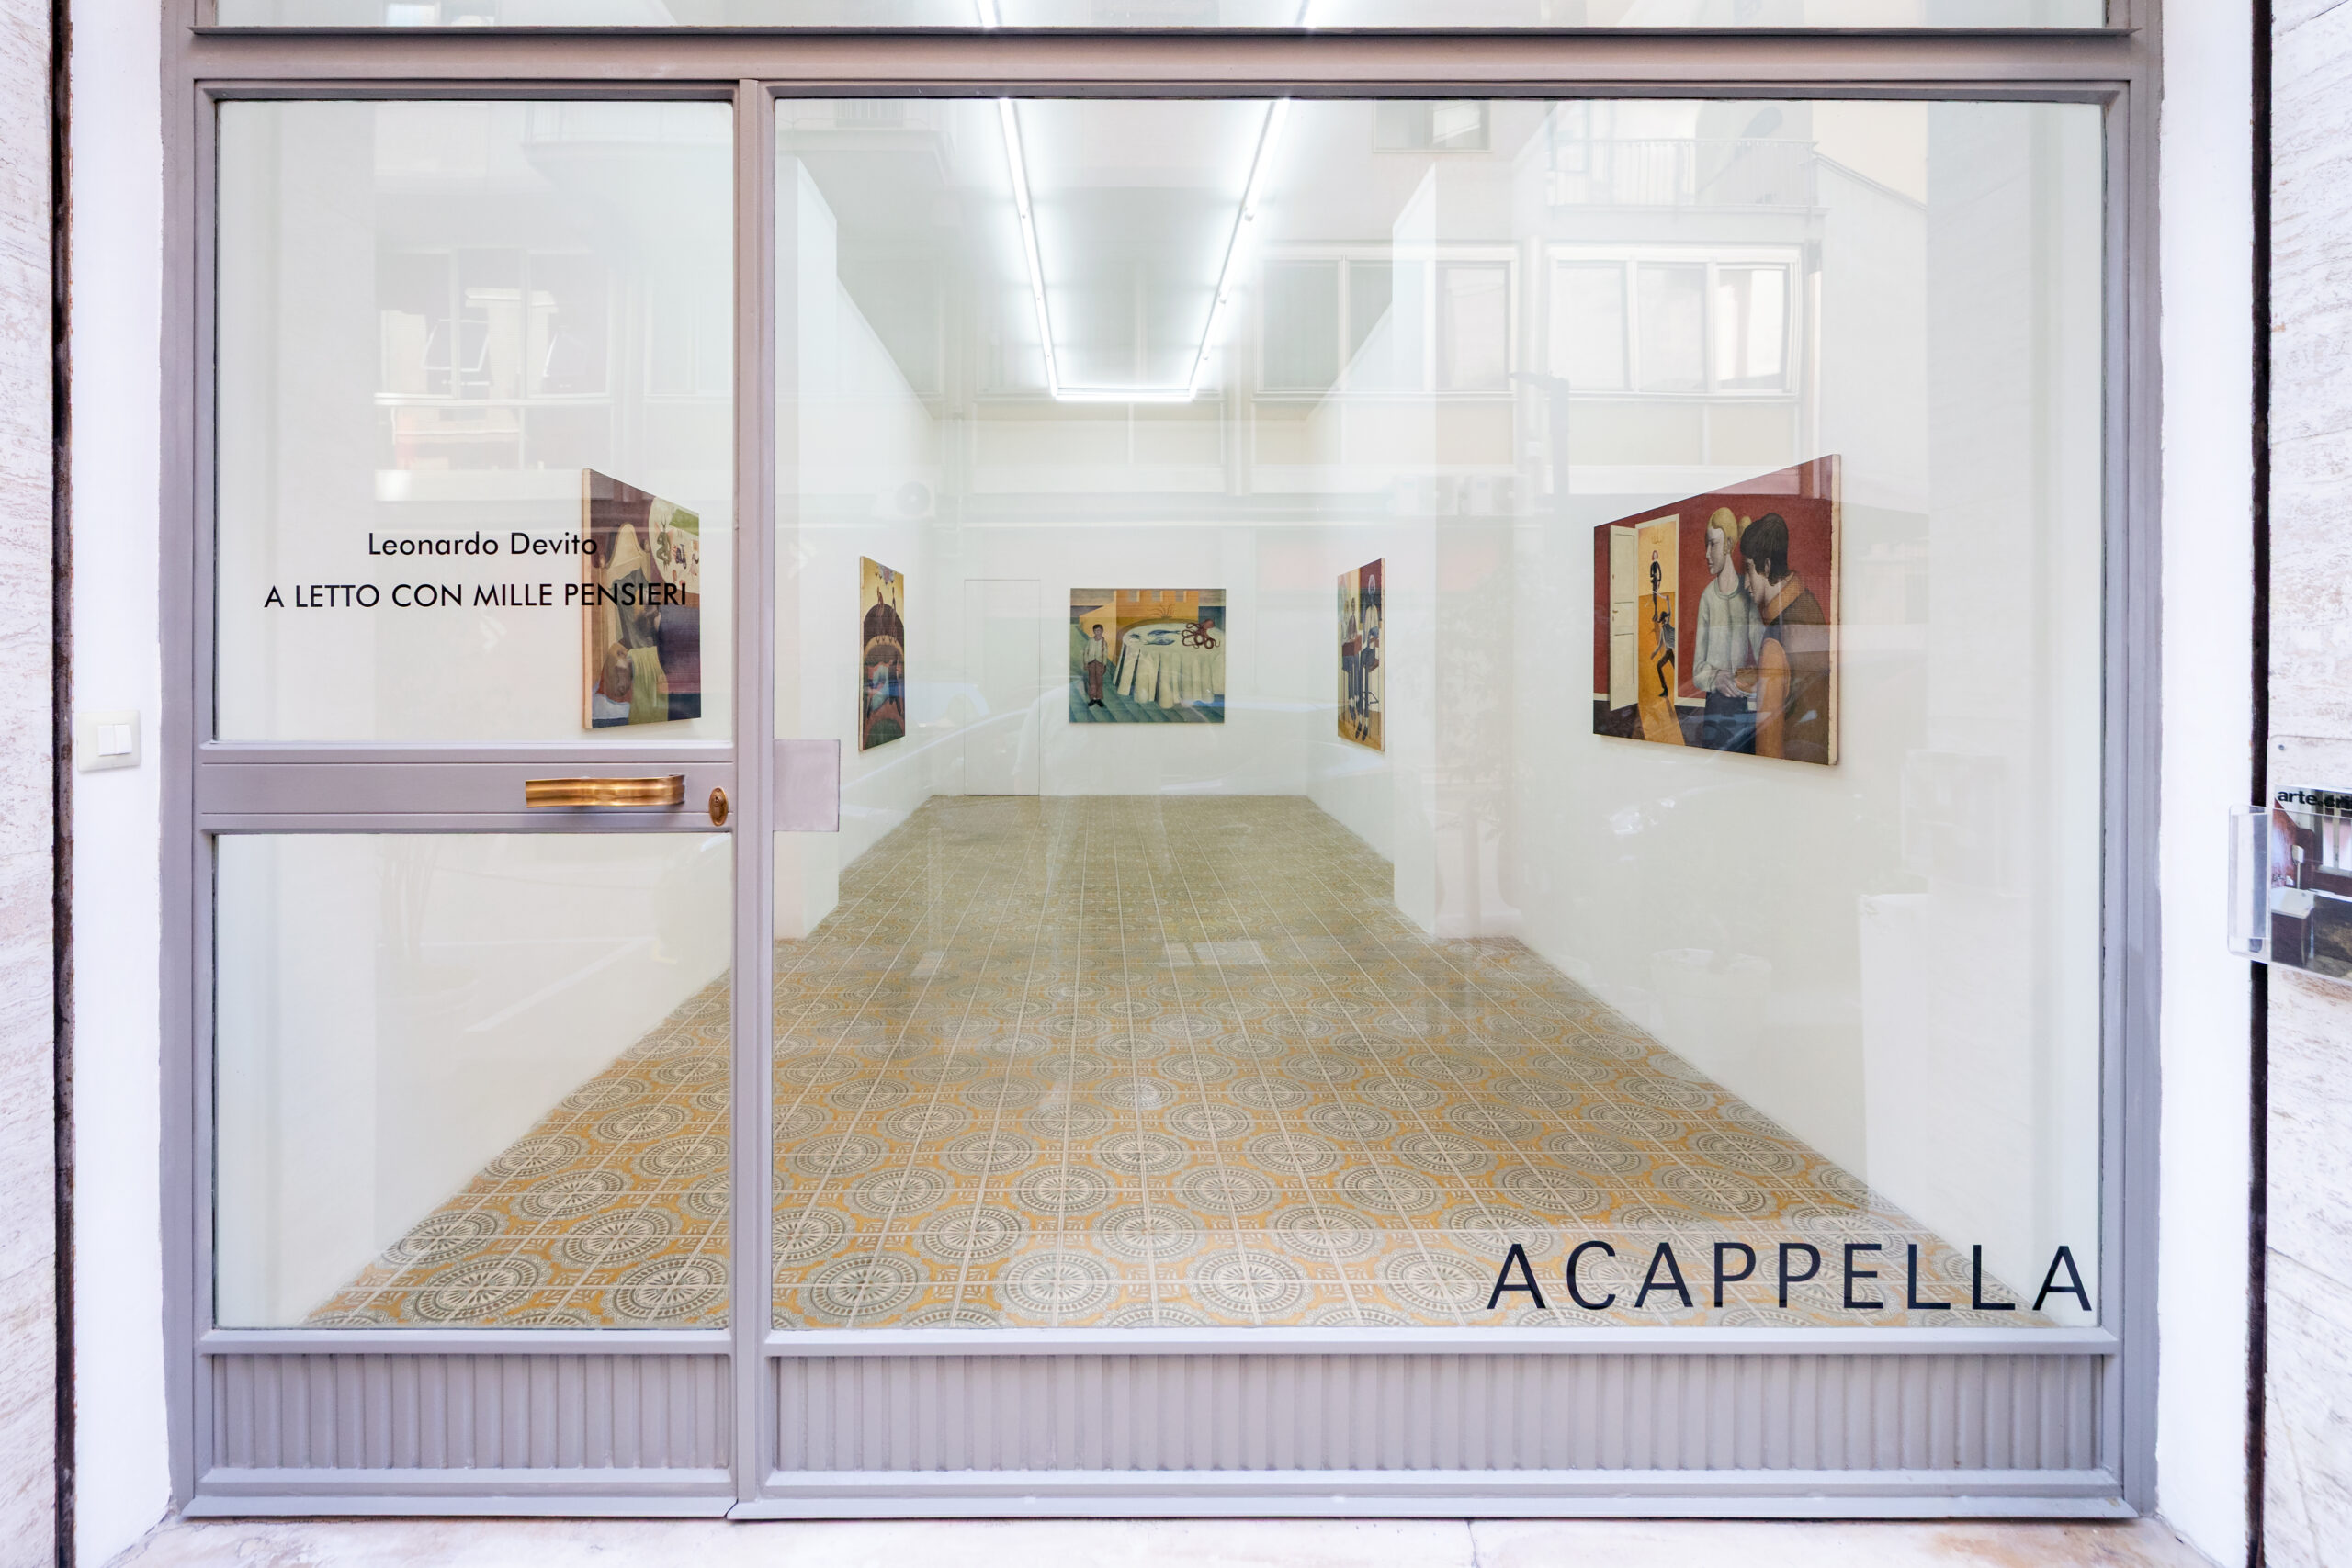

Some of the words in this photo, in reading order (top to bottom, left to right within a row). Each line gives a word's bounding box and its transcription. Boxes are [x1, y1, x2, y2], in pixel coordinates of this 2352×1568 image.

[368, 531, 499, 556] Leonardo
[510, 531, 598, 555] Devito
[264, 584, 285, 608] A
[295, 583, 380, 608] LETTO
[391, 583, 462, 607] CON
[473, 582, 553, 606] MILLE
[564, 582, 687, 606] PENSIERI
[1487, 1240, 2093, 1312] ACAPPELLA
